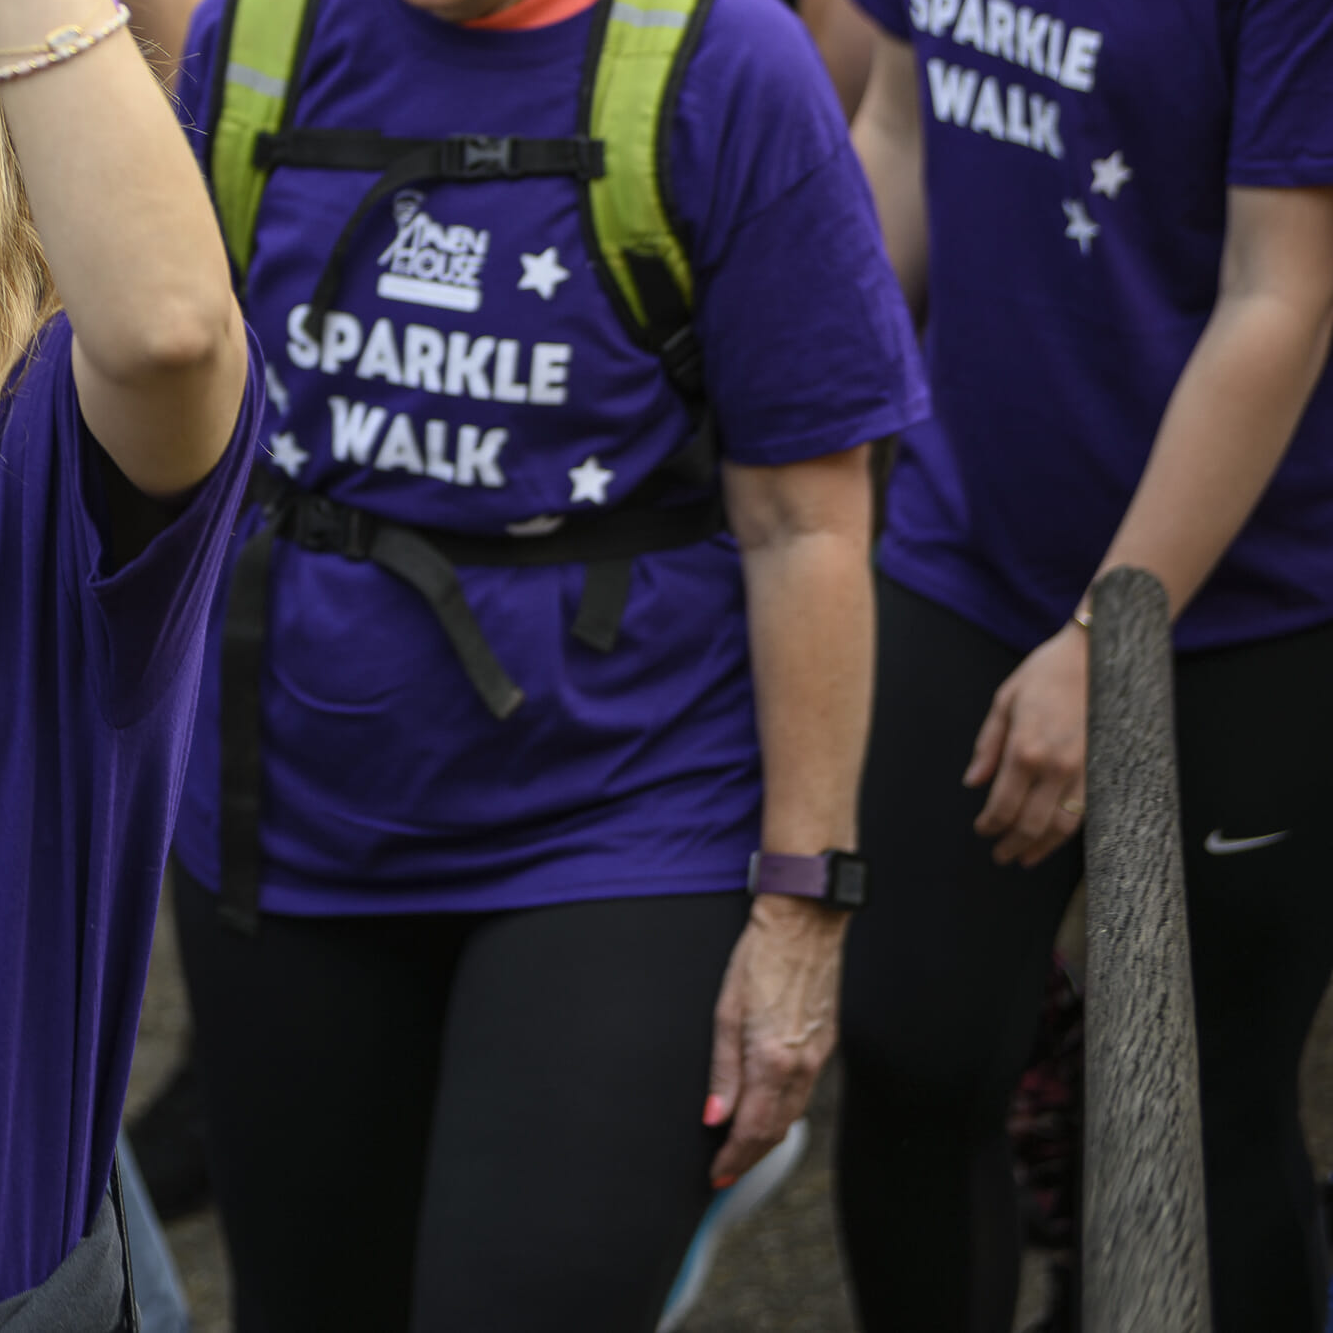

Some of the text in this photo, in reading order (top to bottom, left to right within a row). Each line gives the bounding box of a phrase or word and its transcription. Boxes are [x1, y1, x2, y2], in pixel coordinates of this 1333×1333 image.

[926, 57, 1065, 160] WALK
[286, 303, 572, 407] SPARKLE
[328, 395, 510, 489] WALK
